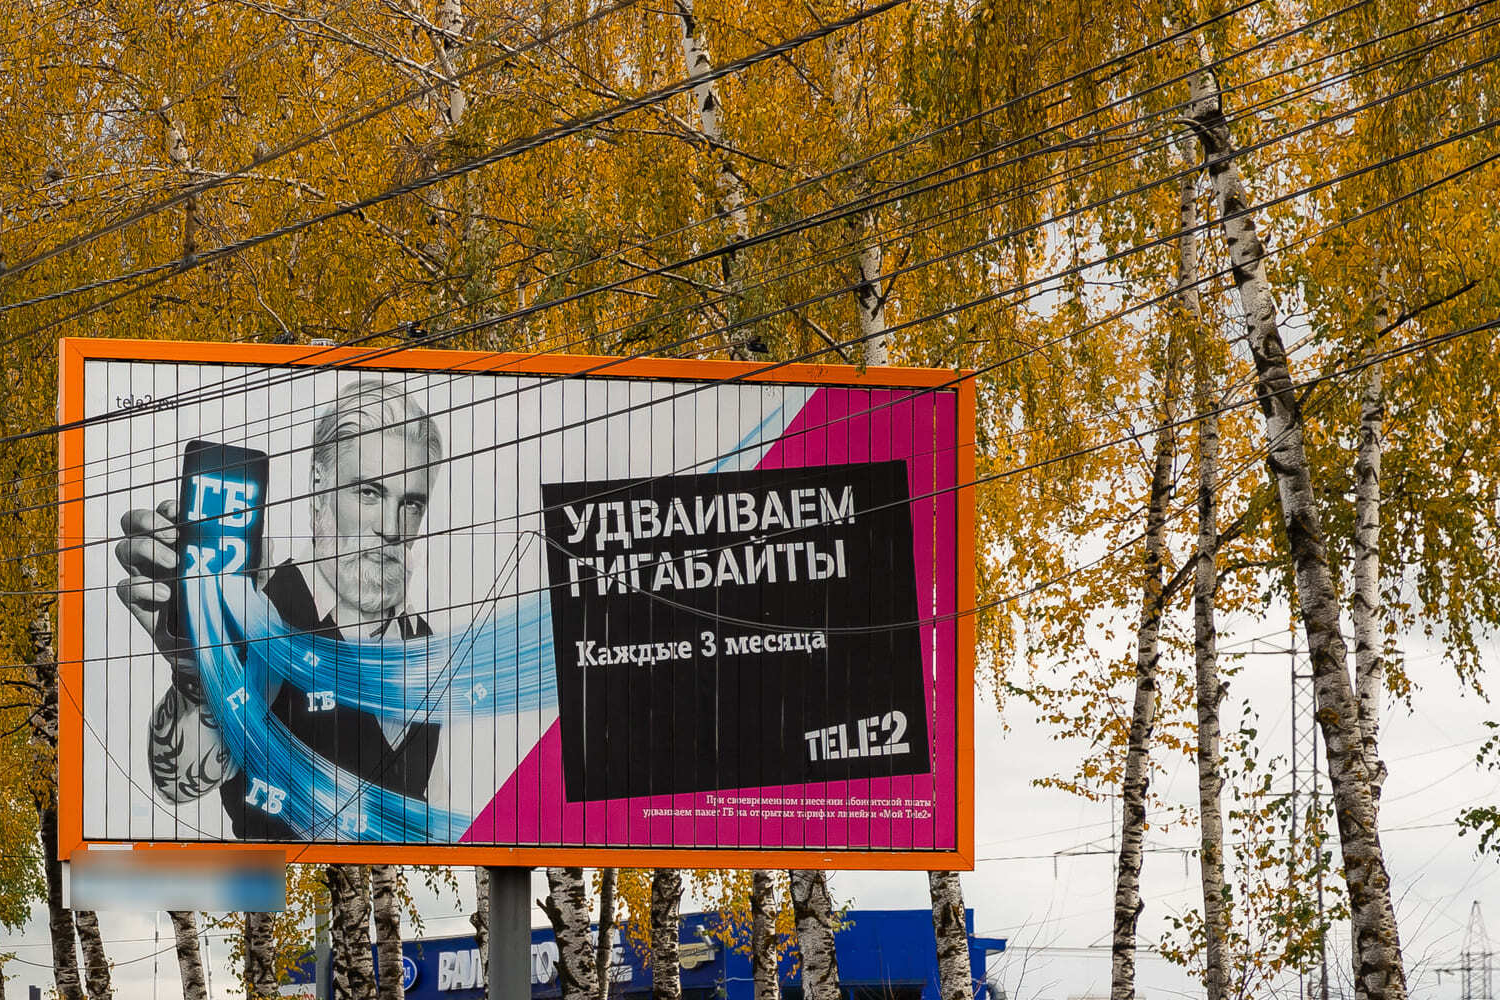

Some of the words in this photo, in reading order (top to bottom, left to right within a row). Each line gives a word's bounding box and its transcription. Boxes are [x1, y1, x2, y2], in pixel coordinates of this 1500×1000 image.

[187, 474, 255, 528] ГБ
[564, 486, 856, 550] УДВАИВАЕМ
[569, 536, 848, 597] ГИГАБАЙТЫ
[576, 639, 692, 667] Каждые
[701, 631, 717, 658] 3
[725, 631, 828, 656] месяца
[307, 691, 336, 712] ГБ
[804, 710, 911, 761] TELE2
[246, 777, 287, 814] ГБ
[706, 795, 724, 806] При
[722, 807, 734, 816] ГБ
